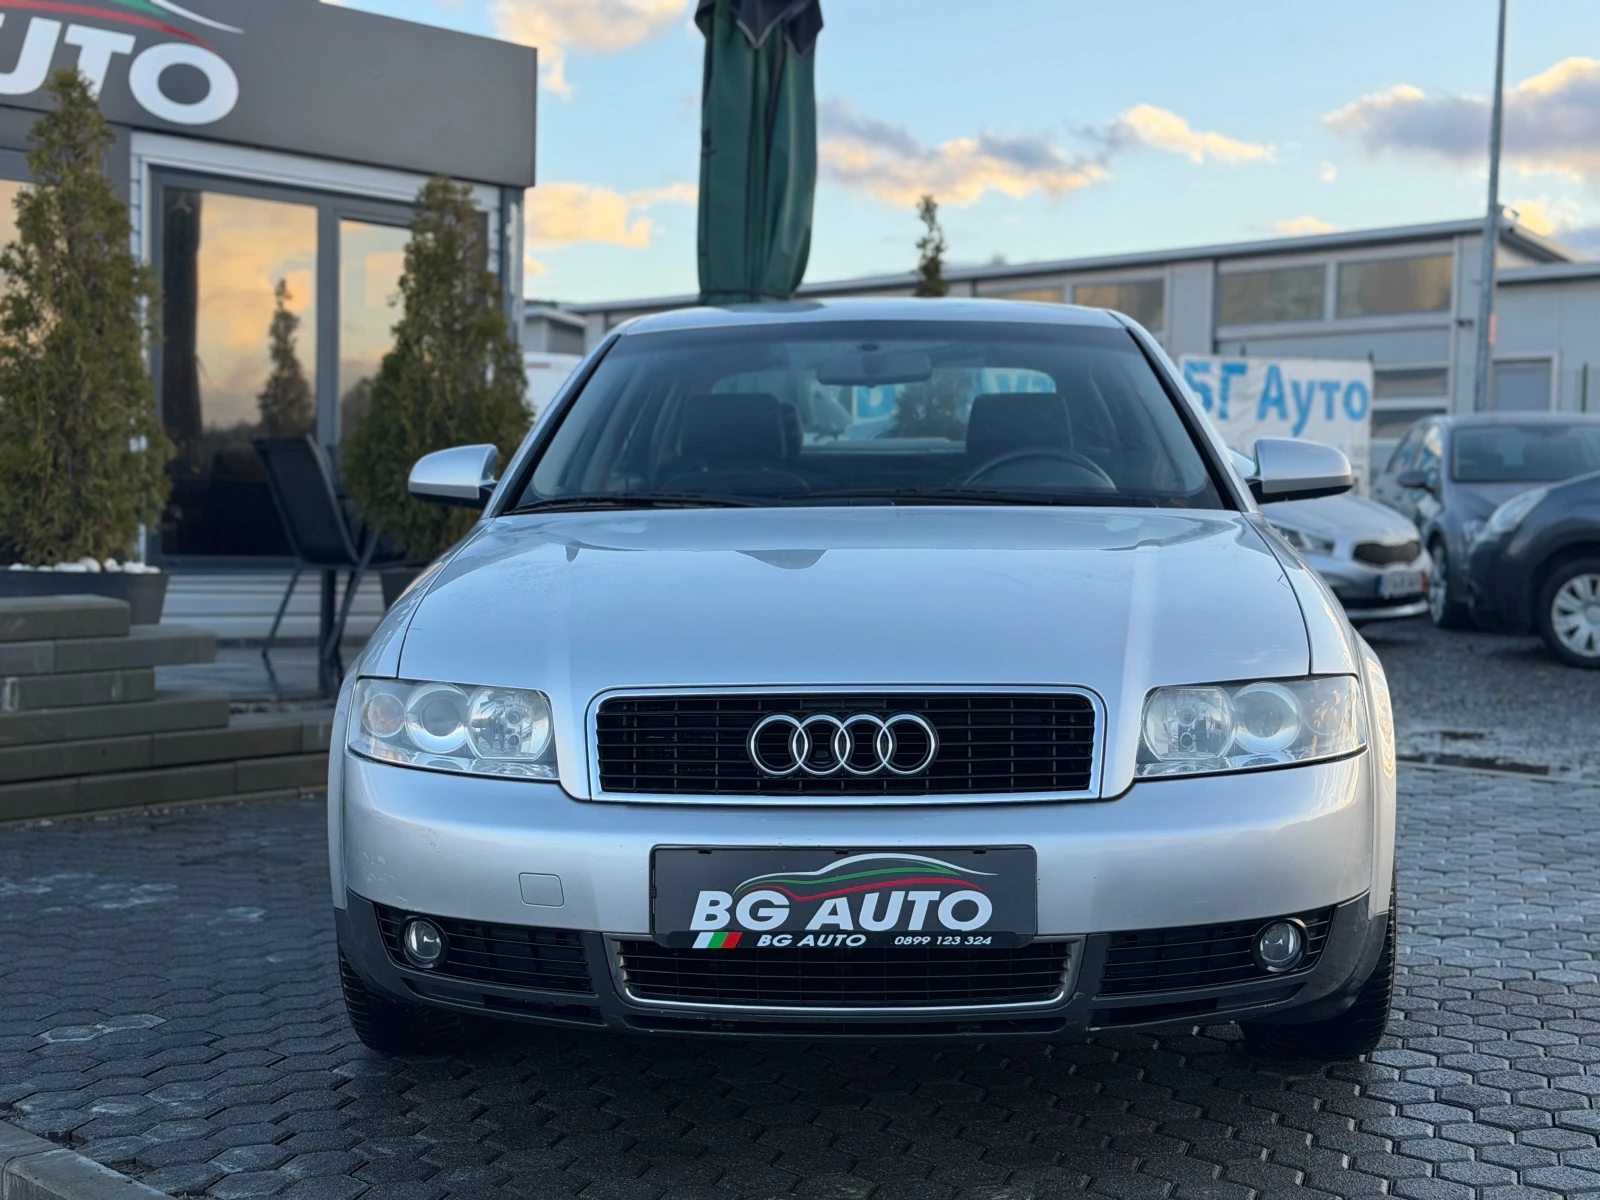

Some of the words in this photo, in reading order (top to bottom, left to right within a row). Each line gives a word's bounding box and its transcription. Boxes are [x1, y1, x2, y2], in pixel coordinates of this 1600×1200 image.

[1256, 364, 1370, 438] Ауто
[690, 890, 790, 931] BG
[805, 890, 993, 931] AUTO
[756, 934, 793, 947] BG
[796, 934, 867, 947] AUTO
[894, 936, 931, 945] 0899
[936, 936, 961, 945] 123
[964, 936, 993, 945] 324
